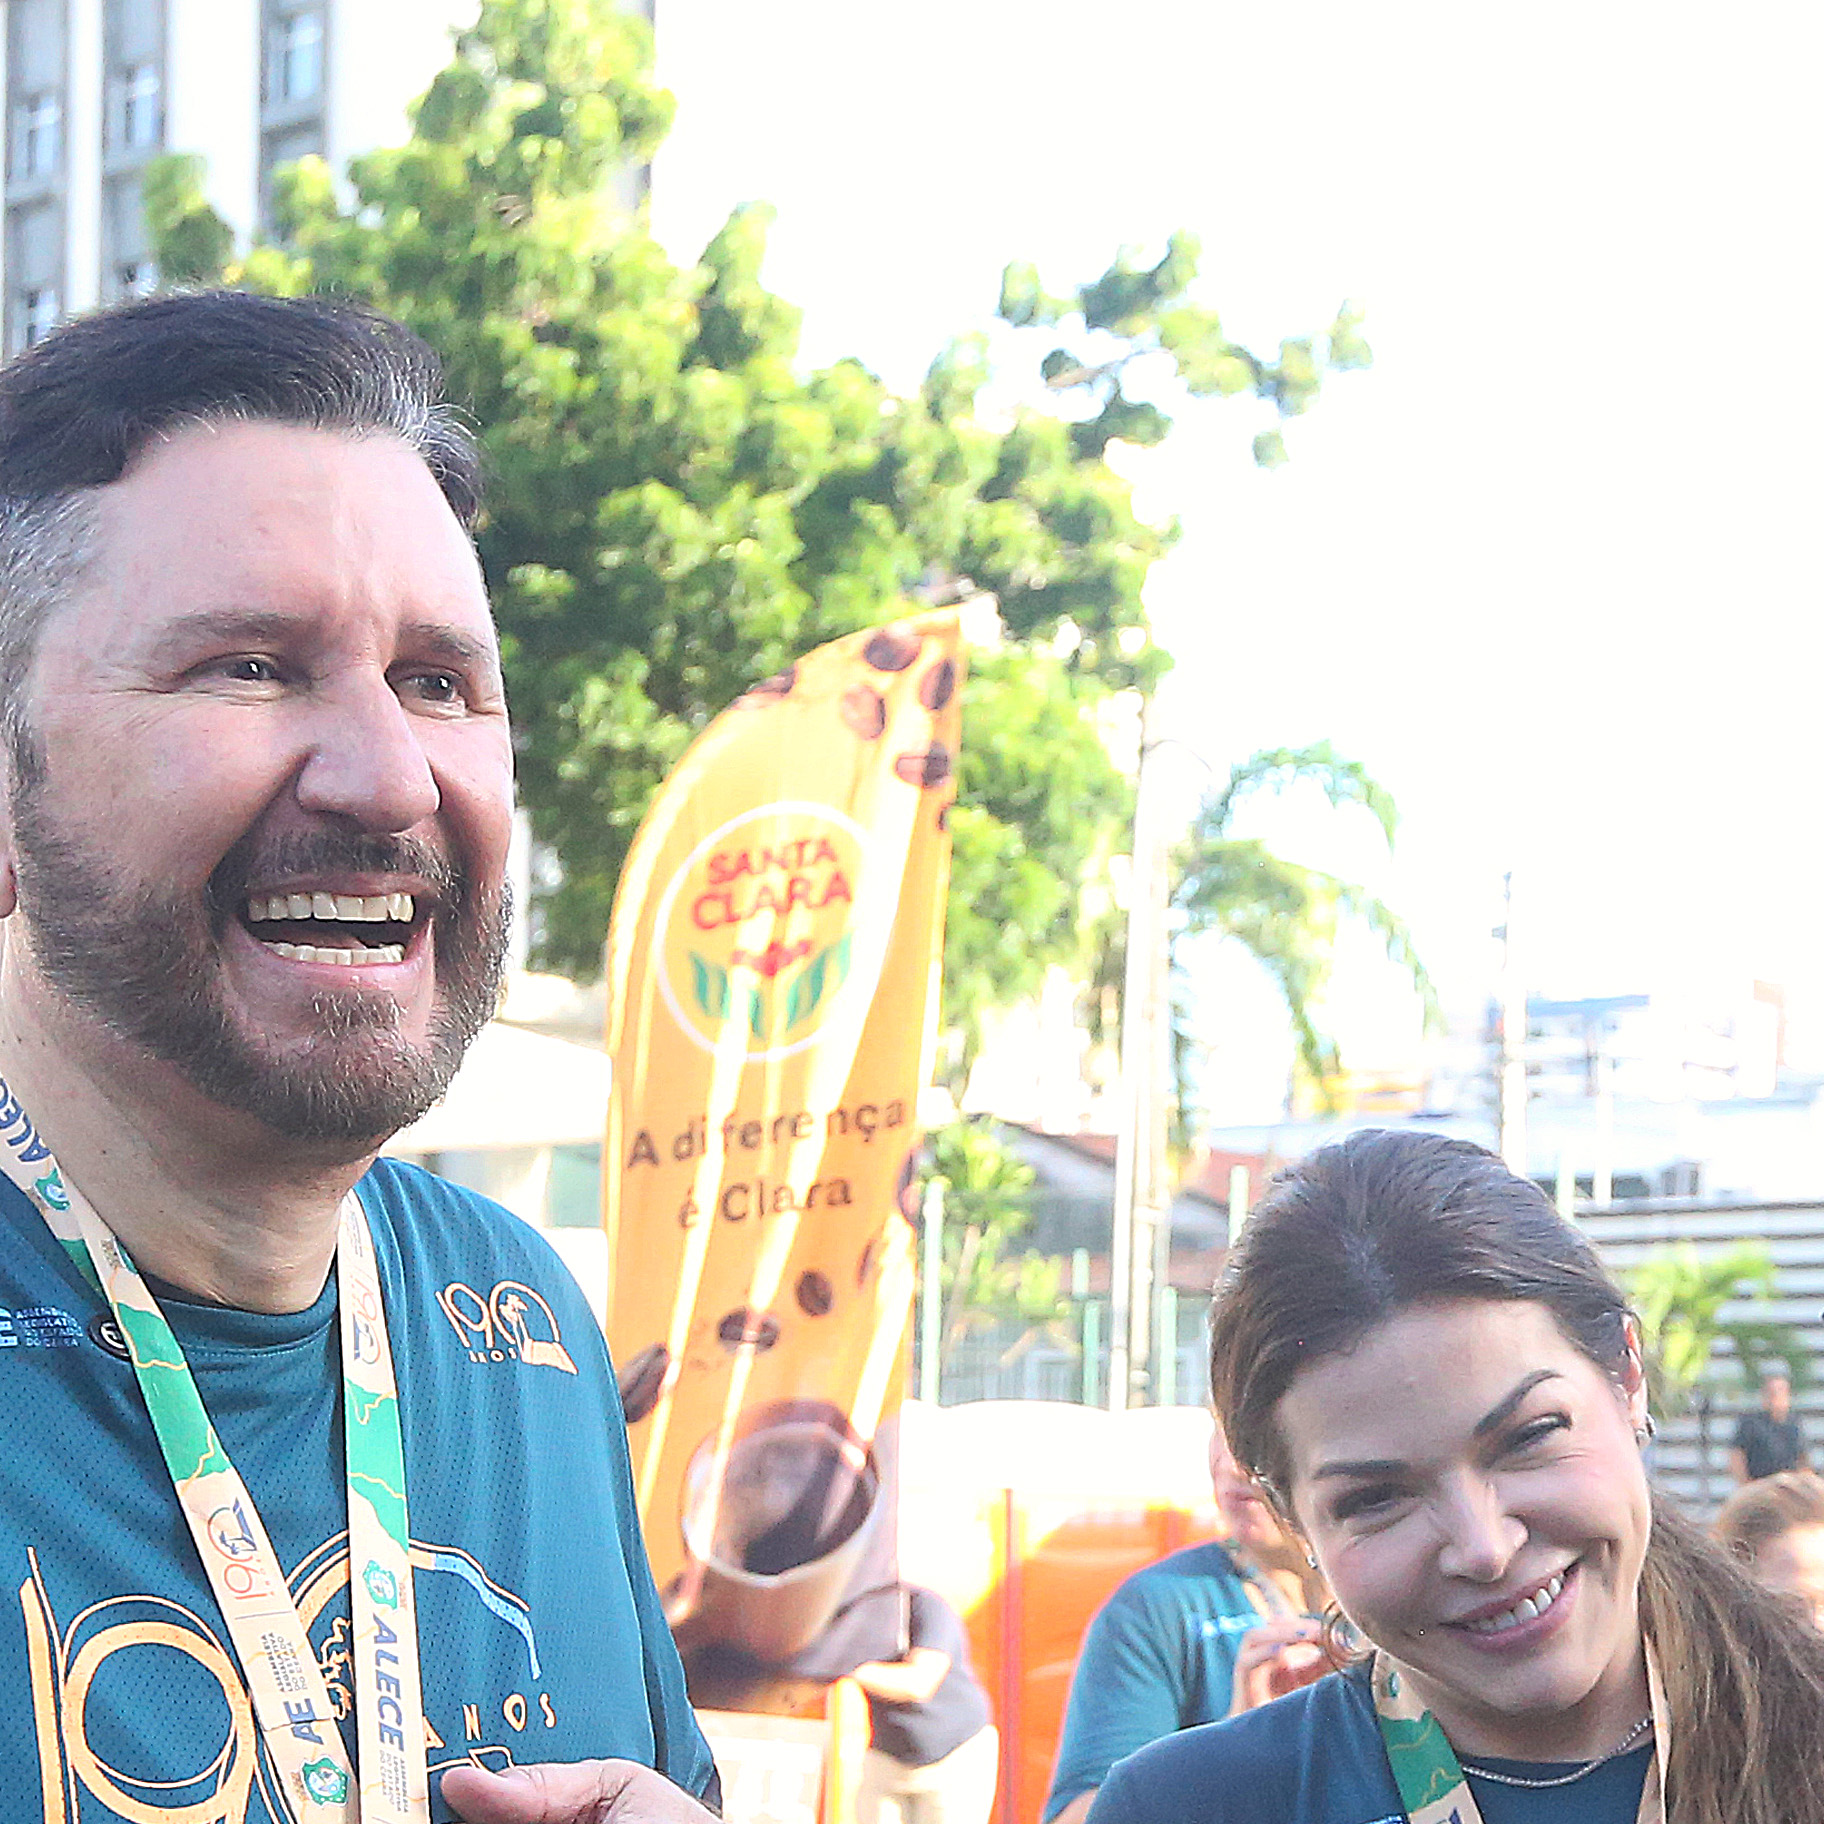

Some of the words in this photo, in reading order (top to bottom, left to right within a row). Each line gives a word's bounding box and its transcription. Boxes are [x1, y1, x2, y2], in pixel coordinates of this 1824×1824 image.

[709, 838, 838, 885] SANTA
[691, 871, 853, 932] CLARA
[628, 1128, 660, 1170] A
[721, 1176, 853, 1224] Clara
[372, 1610, 406, 1753] ALECE
[422, 1692, 558, 1750] ANOS
